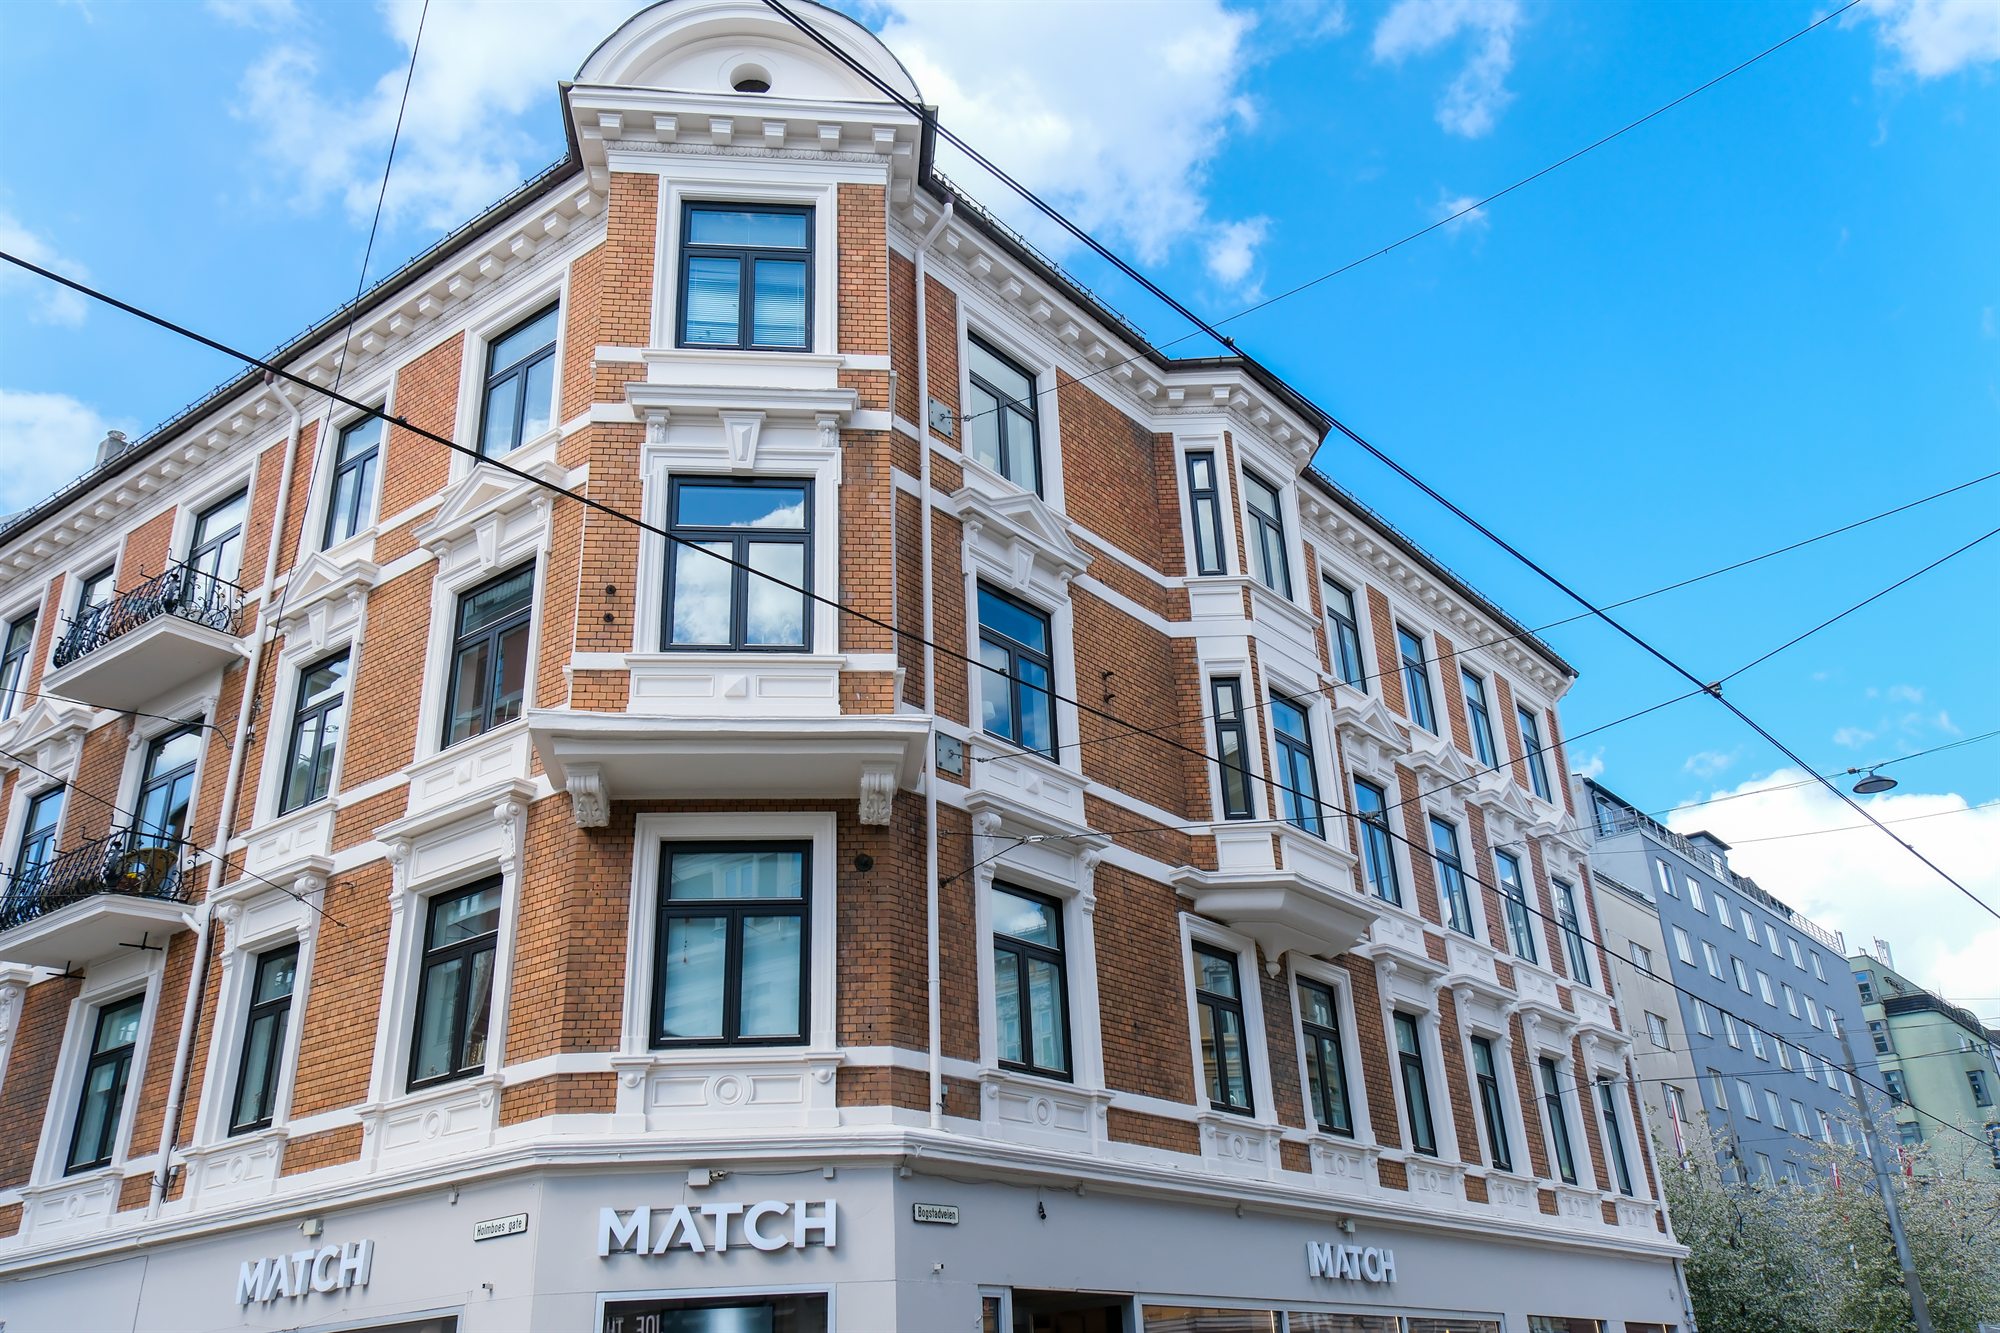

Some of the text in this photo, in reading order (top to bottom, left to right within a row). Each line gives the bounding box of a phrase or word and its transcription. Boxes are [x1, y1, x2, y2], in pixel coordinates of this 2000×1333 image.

[476, 1218, 522, 1236] Holmboes gate
[598, 1199, 837, 1256] MATCH
[917, 1206, 956, 1220] Bogstadveien
[235, 1239, 374, 1305] MATCH
[1306, 1240, 1397, 1283] MATCH
